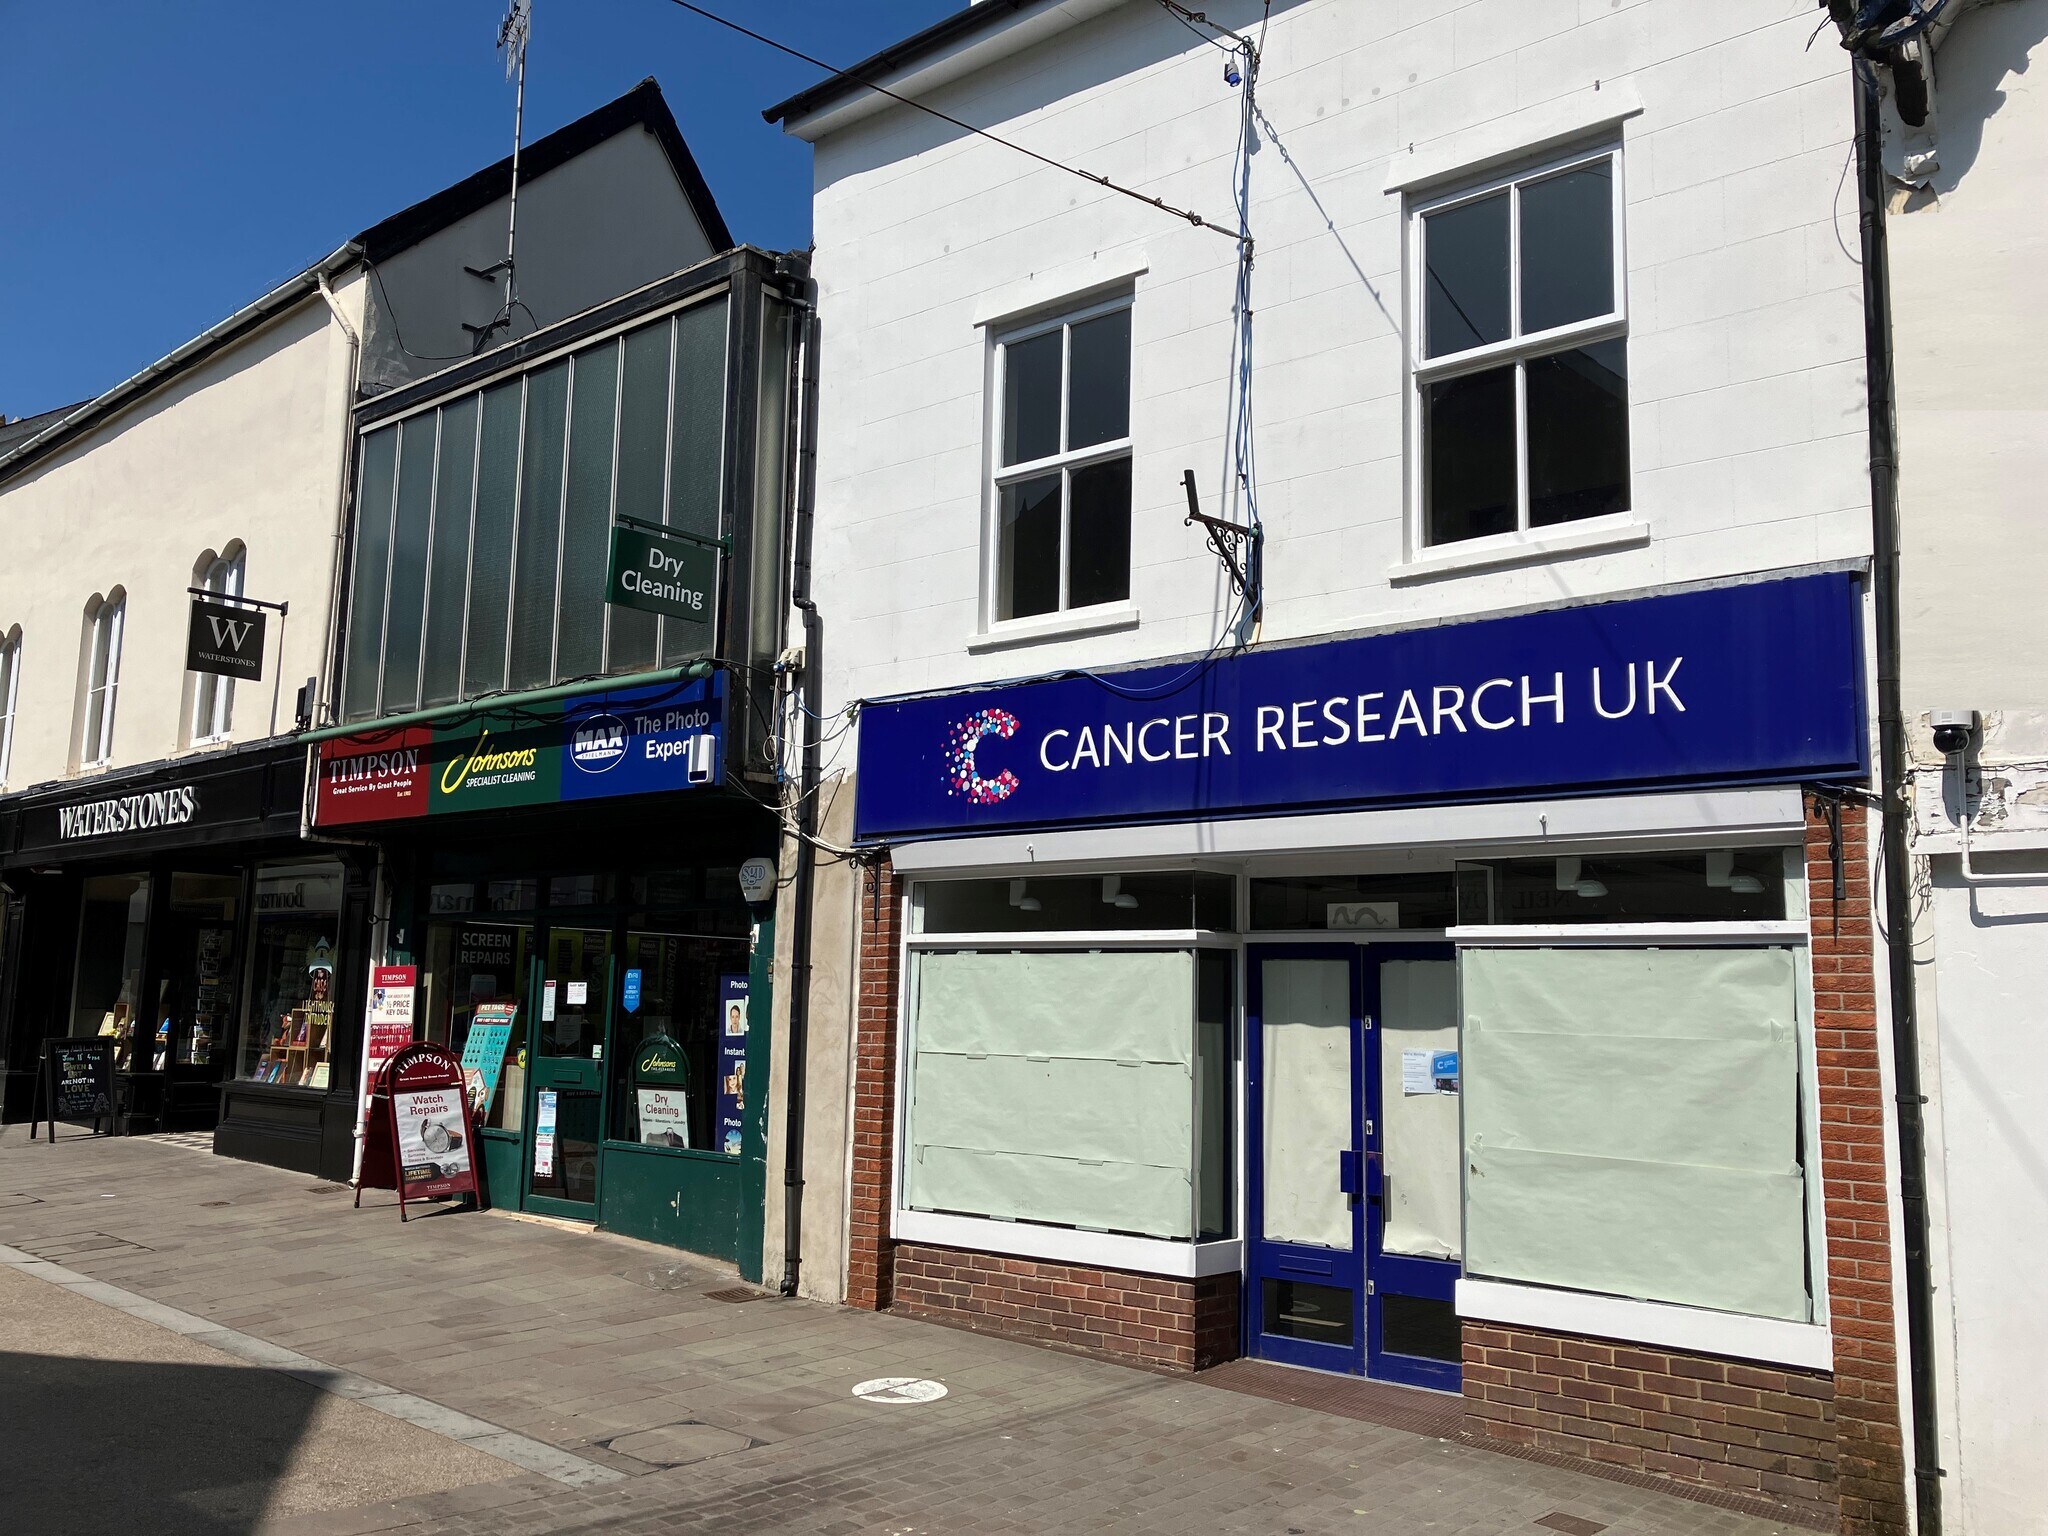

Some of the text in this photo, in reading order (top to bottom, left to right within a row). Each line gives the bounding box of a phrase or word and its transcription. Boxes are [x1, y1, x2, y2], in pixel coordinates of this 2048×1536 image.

[649, 547, 684, 578] Dry
[621, 570, 704, 610] Cleaning
[206, 615, 254, 652] W
[198, 651, 256, 667] WATERSTONES
[1040, 656, 1686, 771] CANCER RESEARCH UK
[634, 709, 709, 735] The Photo
[575, 725, 623, 753] MAX
[581, 750, 616, 759] SPIELMANN
[645, 740, 691, 762] Exper
[329, 749, 420, 784] TIMPSON
[440, 729, 537, 794] Johnsons
[333, 779, 412, 795] Great Service By Great People
[466, 771, 536, 788] SPECIALIST CLEANING
[59, 786, 195, 839] WATERSTONES
[462, 932, 511, 948] SCREEN
[461, 949, 511, 965] REPAIRS
[730, 980, 748, 989] Photo
[393, 1000, 410, 1008] PRICE
[396, 1008, 409, 1016] DEAL
[724, 1047, 745, 1056] Instant
[395, 1053, 452, 1075] TIMPSON
[641, 1053, 677, 1072] Johnsons
[65, 1084, 90, 1093] LOVE
[412, 1094, 443, 1105] Watch
[655, 1093, 668, 1106] Dry
[410, 1104, 449, 1116] Repairs
[645, 1103, 679, 1117] Cleaning
[724, 1117, 742, 1127] Photo
[405, 1168, 432, 1177] LIFETIME
